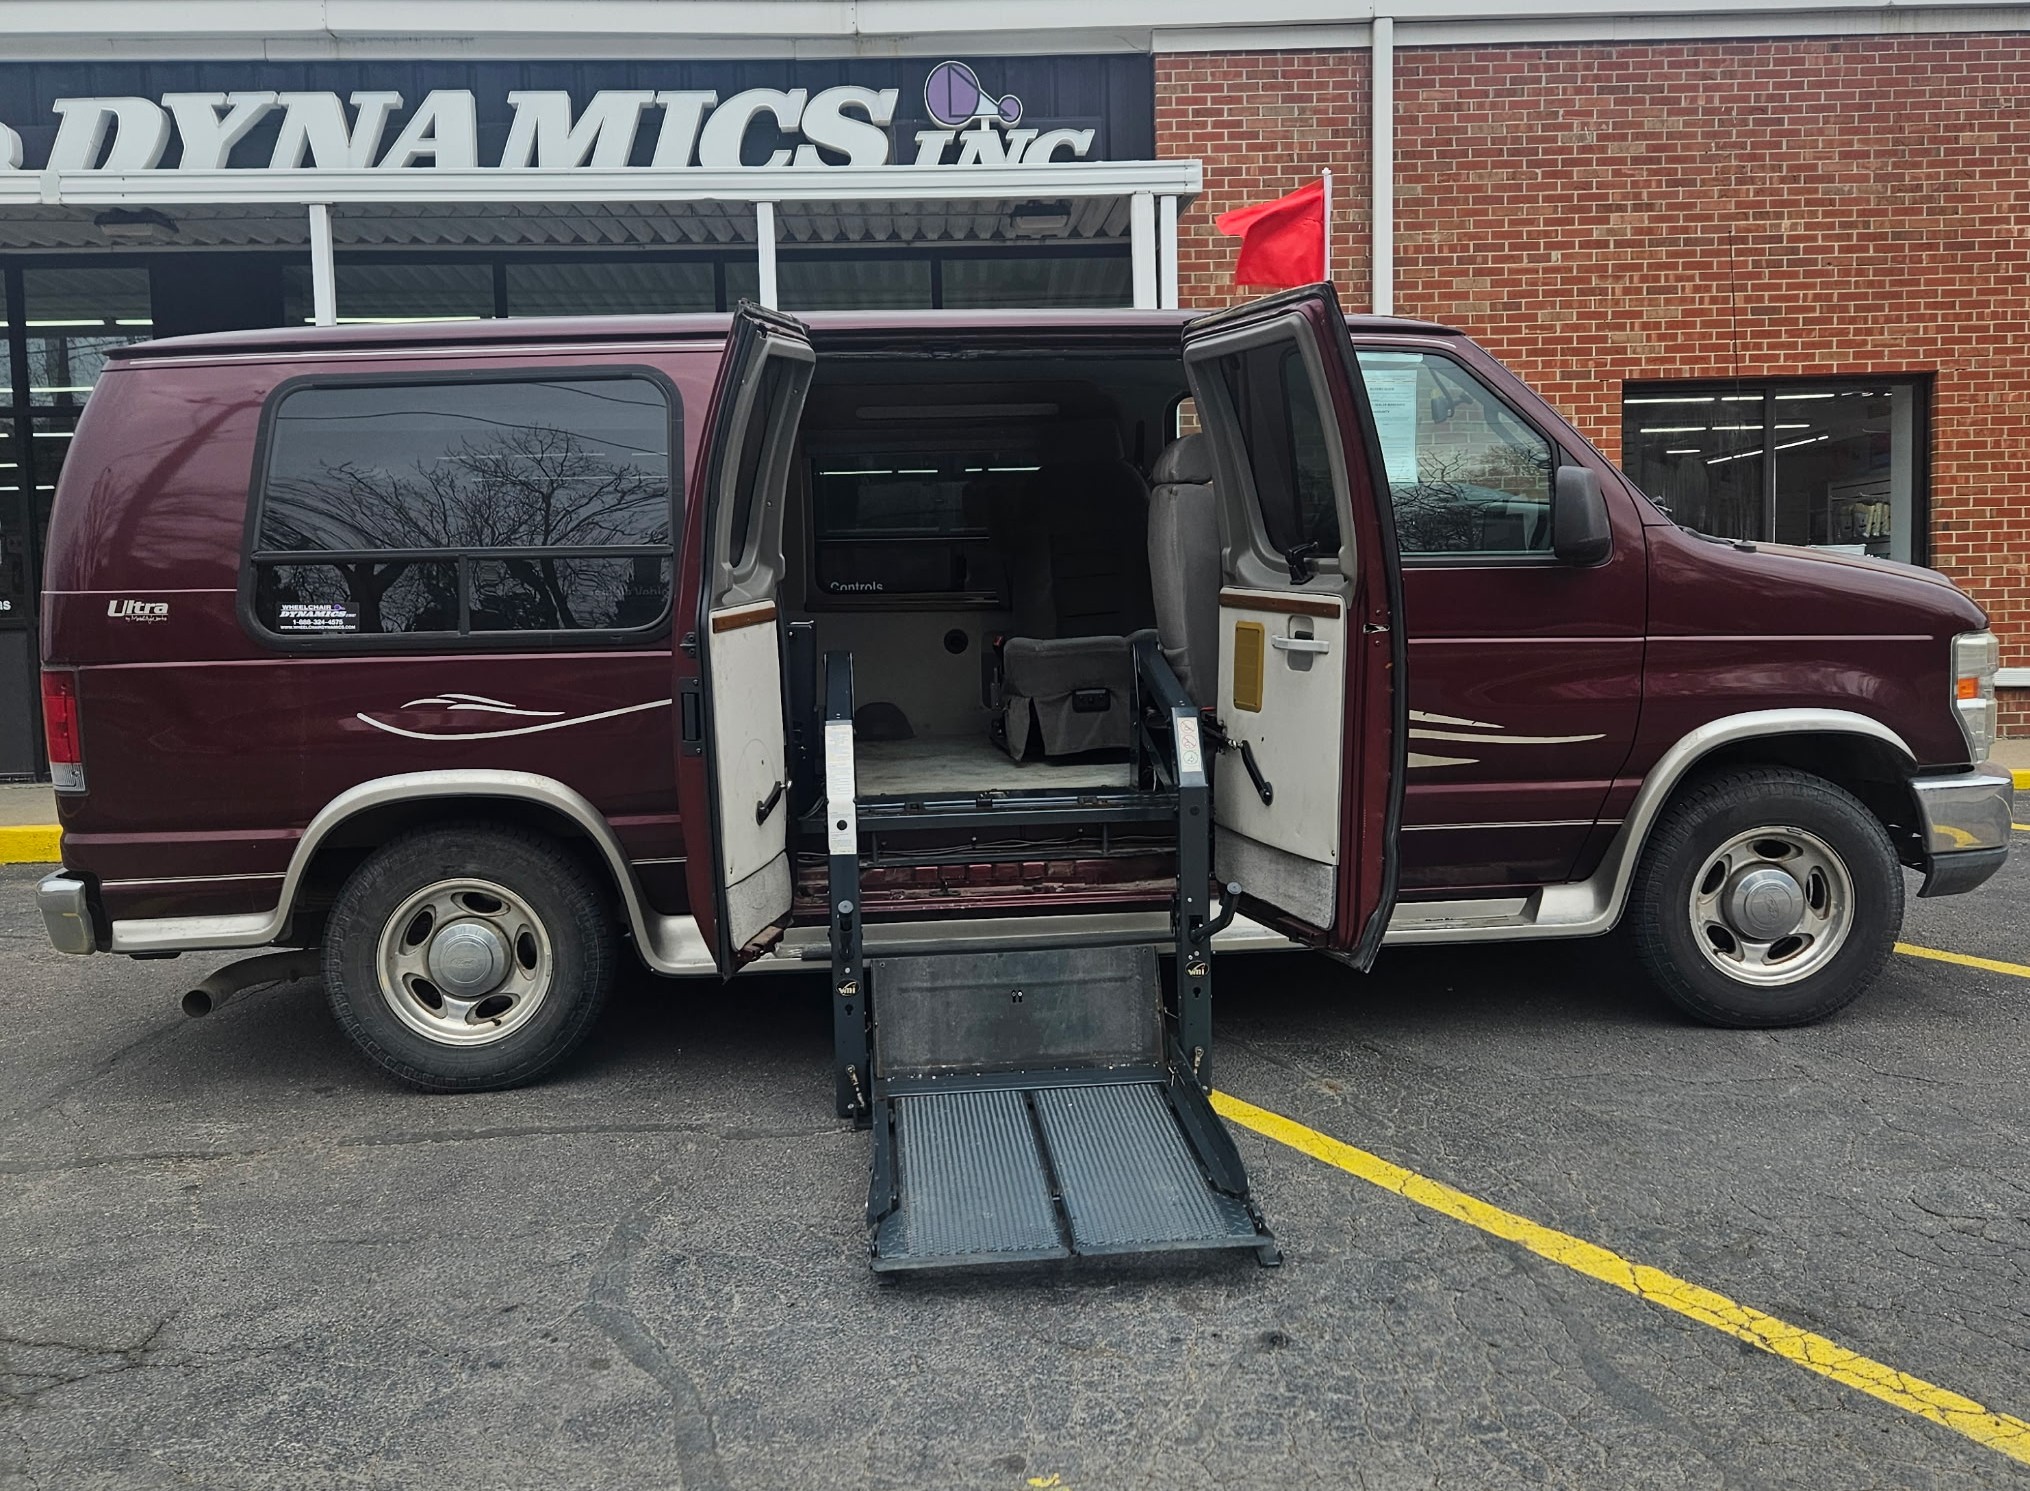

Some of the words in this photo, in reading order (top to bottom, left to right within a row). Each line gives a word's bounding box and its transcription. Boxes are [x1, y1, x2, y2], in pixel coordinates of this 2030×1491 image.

[46, 86, 899, 169] DYNAMICS
[912, 128, 1096, 166] INC
[830, 580, 883, 591] Controls
[107, 600, 168, 616] Ultra
